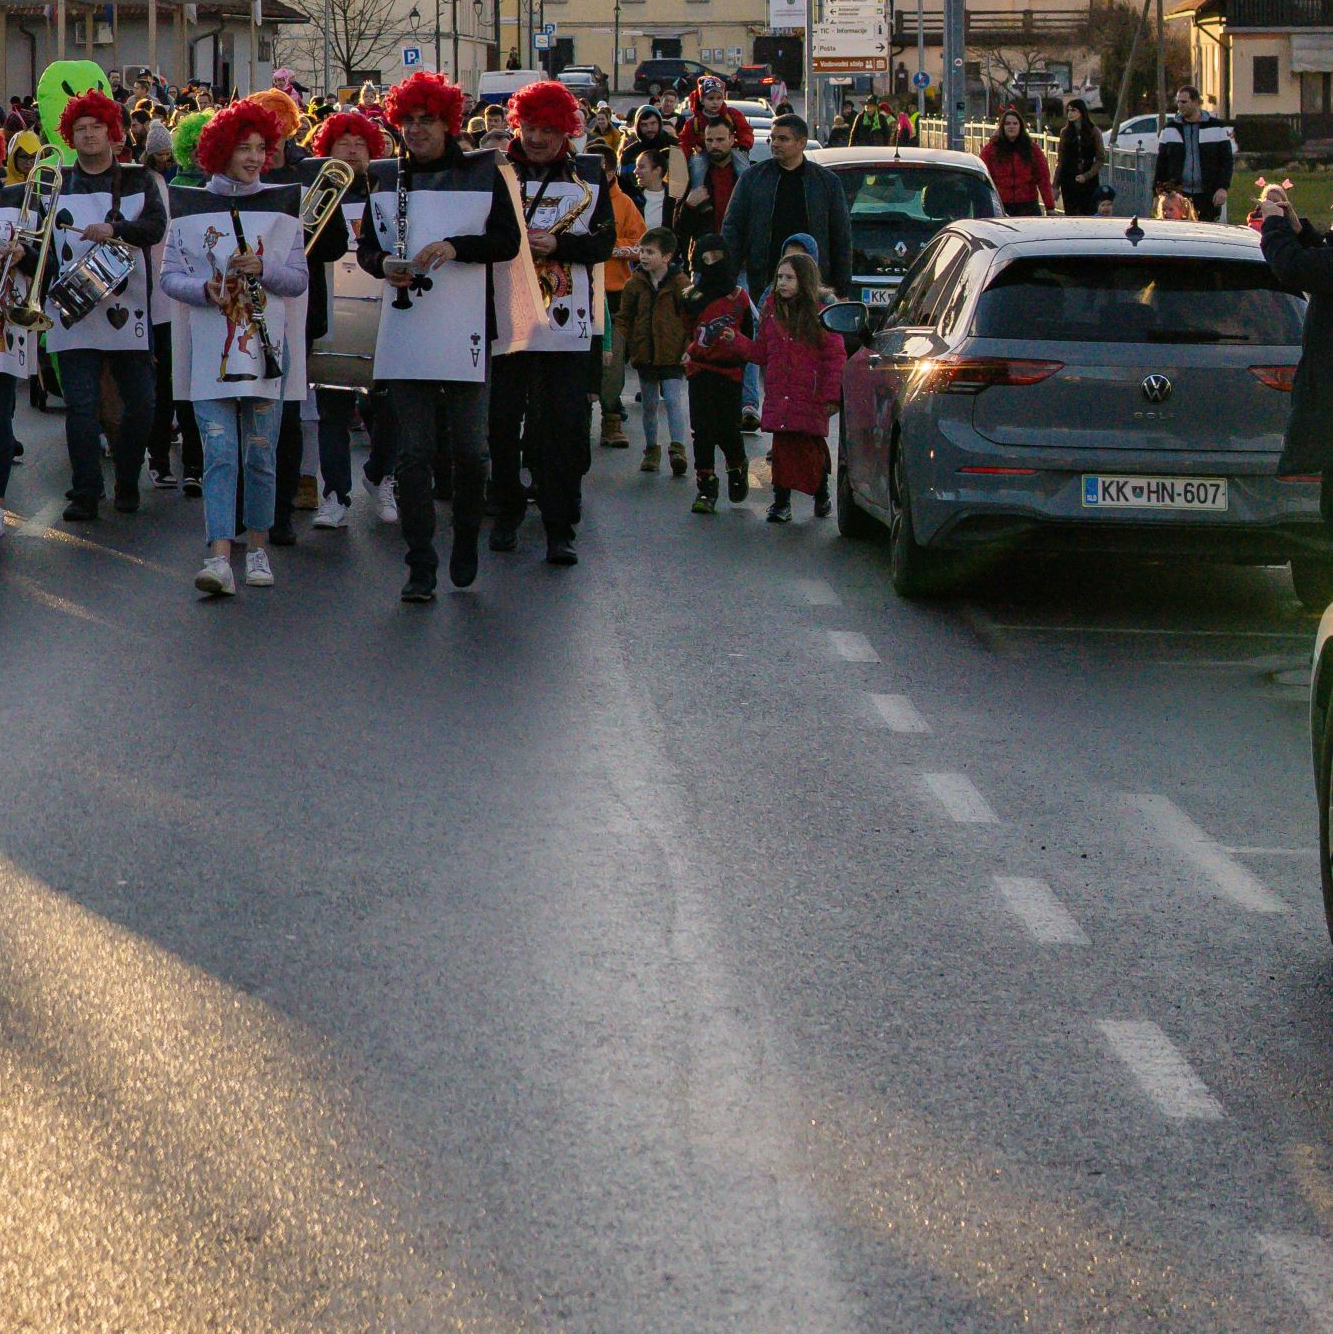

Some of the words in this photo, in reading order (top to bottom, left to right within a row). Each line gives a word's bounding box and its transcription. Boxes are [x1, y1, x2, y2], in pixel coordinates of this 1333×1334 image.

[374, 201, 383, 220] A
[871, 291, 886, 302] KK
[577, 321, 588, 339] K
[470, 348, 481, 367] A
[1101, 480, 1129, 502] KK
[1147, 481, 1221, 504] HN-607
